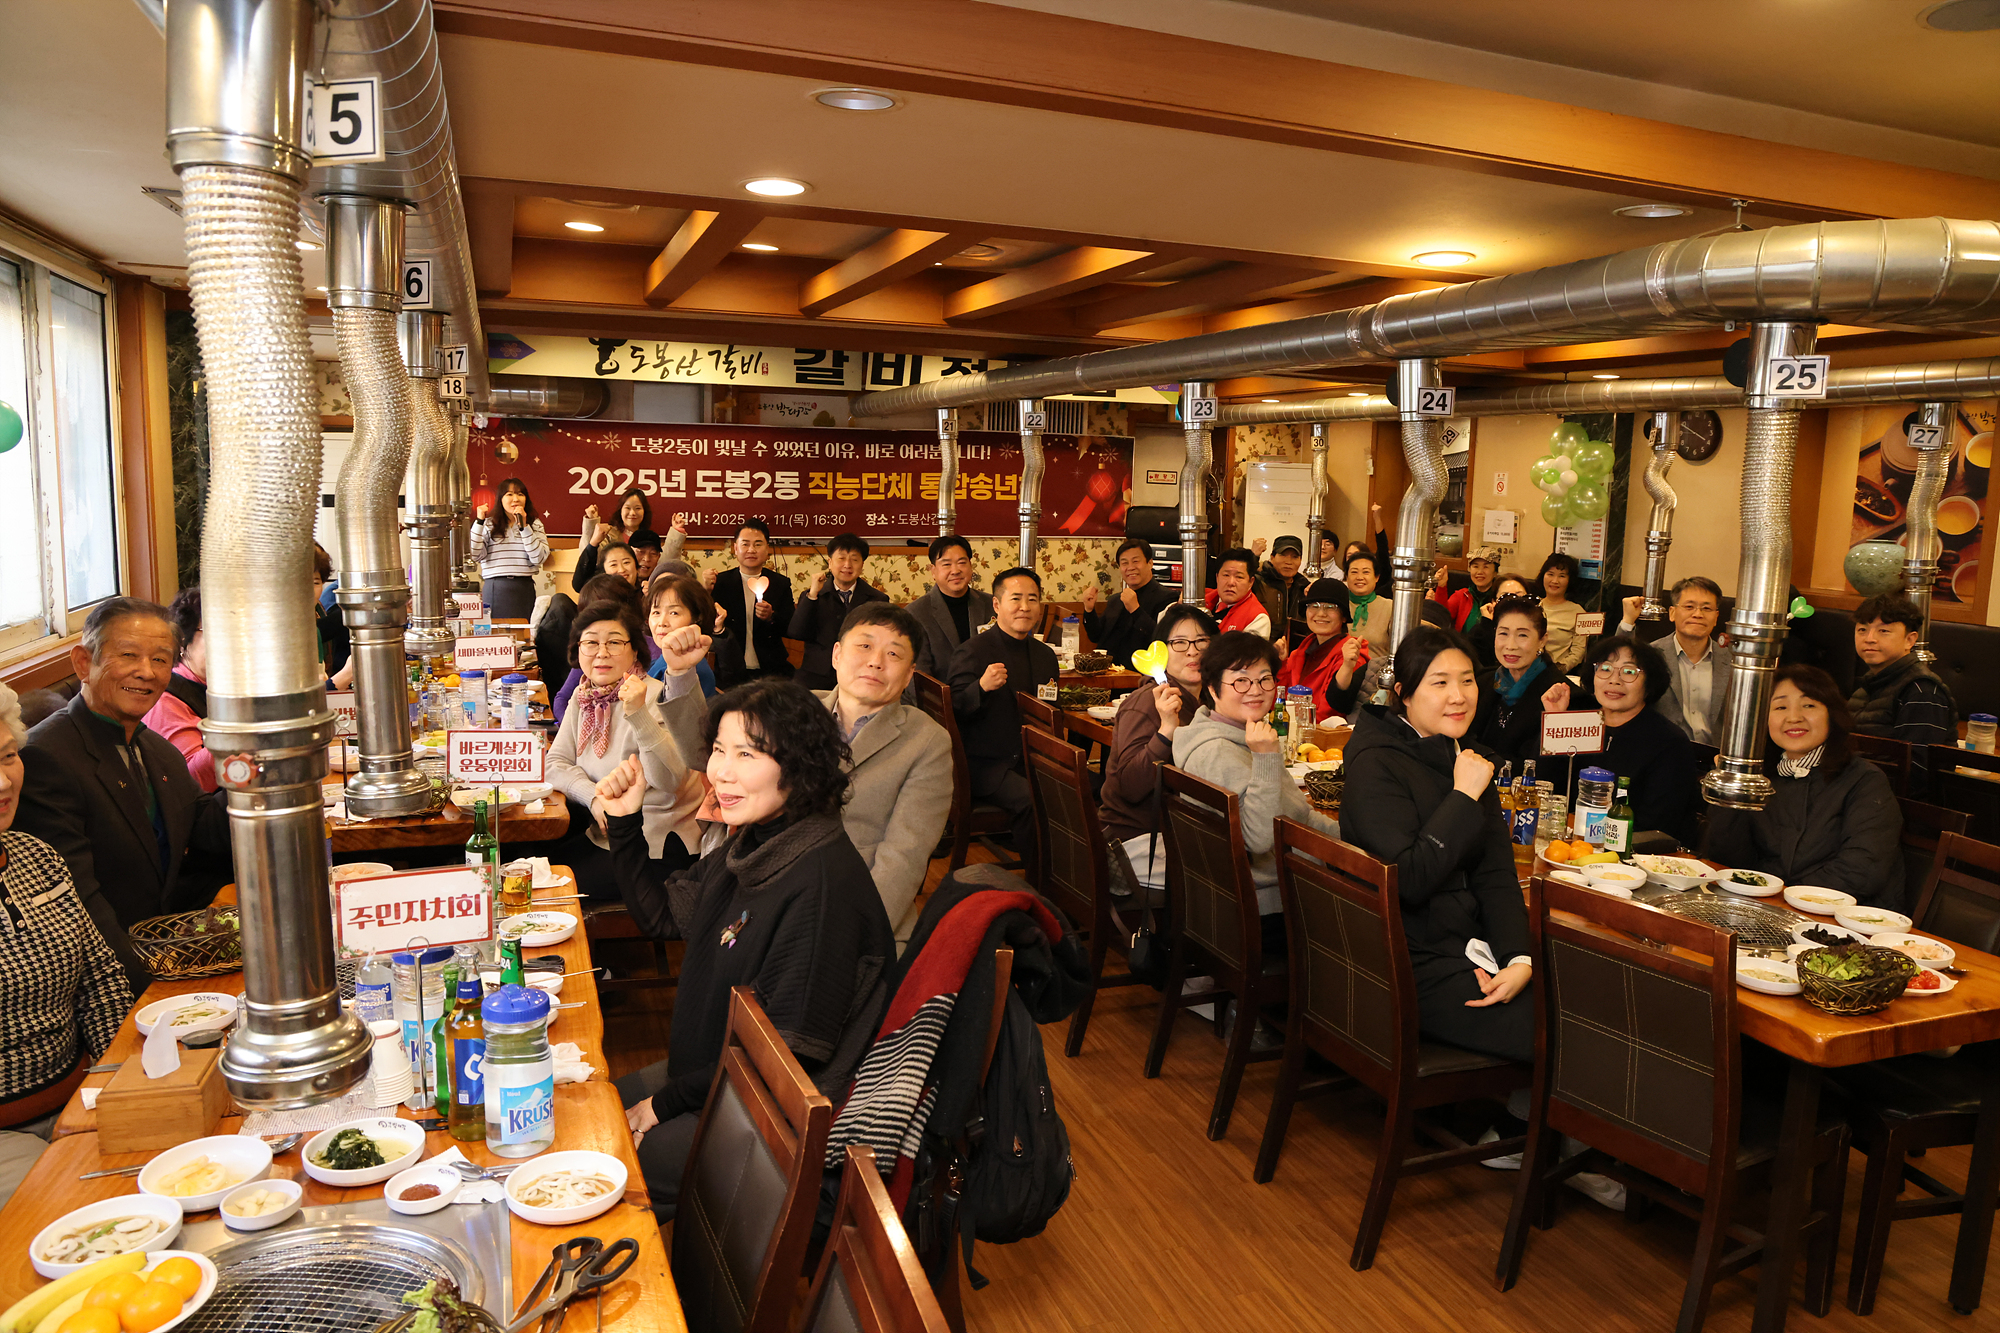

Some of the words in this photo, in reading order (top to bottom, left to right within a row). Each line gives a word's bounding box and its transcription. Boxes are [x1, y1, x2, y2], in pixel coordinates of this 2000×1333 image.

[329, 93, 362, 145] 5
[405, 267, 424, 298] 6
[446, 350, 465, 371] 17
[1775, 363, 1817, 390] 25
[443, 379, 462, 395] 18
[456, 398, 471, 412] 19
[1193, 401, 1213, 416] 23
[1422, 391, 1448, 412] 24
[944, 421, 954, 432] 21
[1027, 415, 1043, 426] 22
[1313, 437, 1325, 448] 30
[1441, 429, 1456, 444] 29
[1913, 428, 1939, 444] 27
[630, 437, 708, 456] 도봉2동이
[752, 441, 768, 456] 수
[773, 441, 820, 459] 있었던
[825, 443, 860, 460] 이유,
[865, 444, 896, 460] 바로
[568, 466, 687, 498] 2025년
[695, 470, 801, 500] 도봉2동
[808, 472, 912, 501] 직능단체
[773, 513, 809, 528] 11.(목)
[812, 514, 847, 526] 16:30
[866, 513, 889, 526] 장소
[457, 646, 513, 658] 새마을부녀회
[1545, 725, 1600, 739] 적십자봉사회
[459, 741, 532, 756] 바르게살기
[459, 758, 532, 773] 운동위원회
[347, 893, 482, 930] 주민자치회
